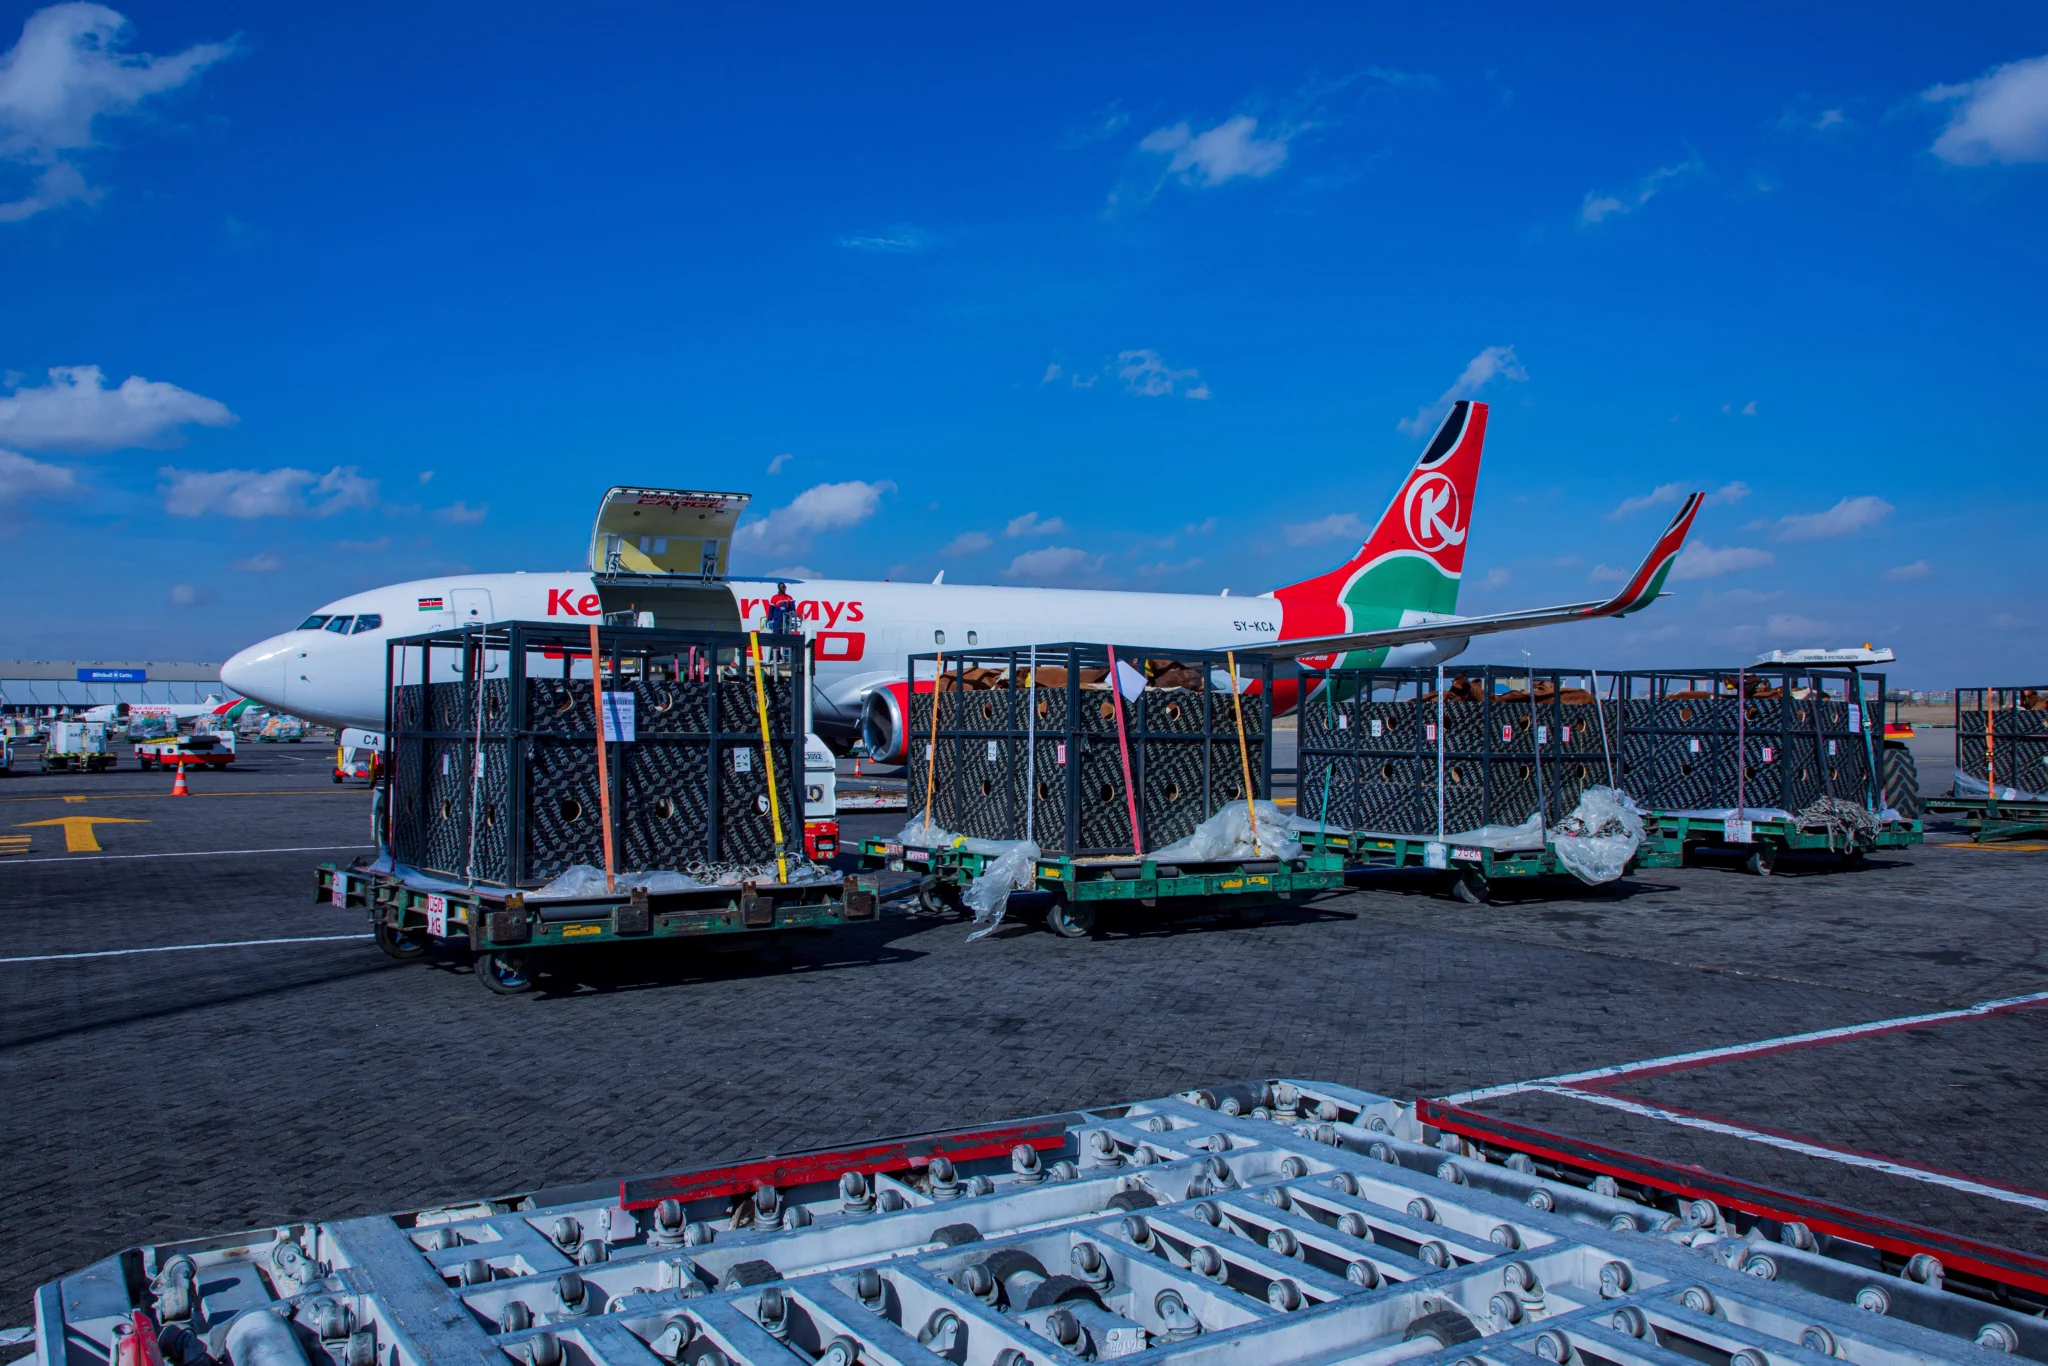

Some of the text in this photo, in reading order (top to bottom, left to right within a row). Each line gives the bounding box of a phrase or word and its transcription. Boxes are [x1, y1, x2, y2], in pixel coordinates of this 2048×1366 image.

[1233, 620, 1276, 633] 5Y-KCA
[635, 680, 655, 712] HRIVE
[731, 684, 754, 722] THRIVE
[363, 734, 379, 746] CA
[571, 710, 586, 733] THR
[685, 713, 699, 733] THR
[724, 758, 746, 796] THRIVE
[575, 782, 600, 821] THRIVE
[677, 788, 700, 827] THRIVE
[536, 806, 560, 847] THRIVE
[630, 820, 651, 859] THRIVE
[728, 825, 751, 863] THRIVE
[740, 817, 762, 855] THRIVE
